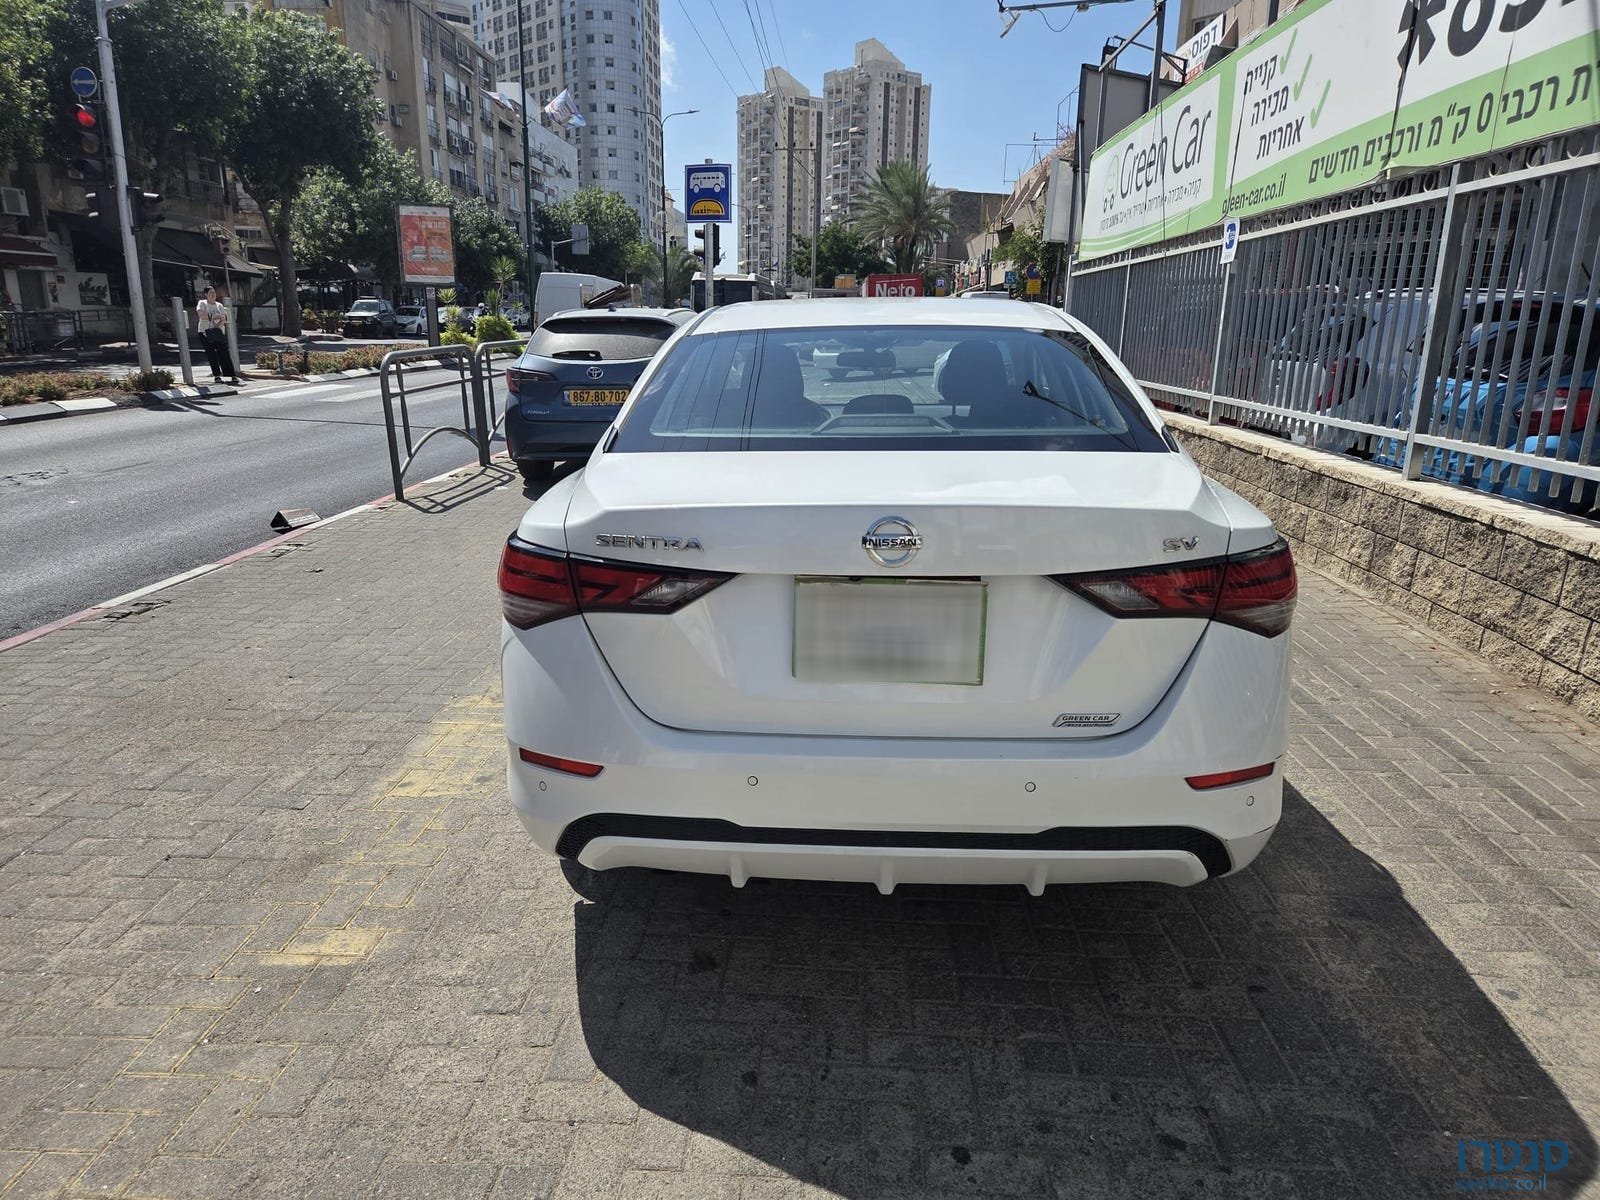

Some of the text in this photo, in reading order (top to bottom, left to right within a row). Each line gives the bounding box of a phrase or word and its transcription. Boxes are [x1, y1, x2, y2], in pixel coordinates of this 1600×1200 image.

[1191, 24, 1218, 59] דפוס
[1250, 85, 1289, 126] מכירה
[1477, 92, 1494, 134] 0
[1501, 75, 1560, 125] רכבי
[1120, 105, 1211, 199] Green Car
[1256, 116, 1305, 160] אחריות
[1363, 121, 1423, 168] ורכבים
[1308, 144, 1359, 184] חדשים
[1222, 172, 1287, 215] geen-car.co.il
[875, 281, 916, 297] Neto
[596, 533, 704, 553] SENTRA
[868, 537, 917, 549] NISSAN
[1163, 536, 1200, 553] SV
